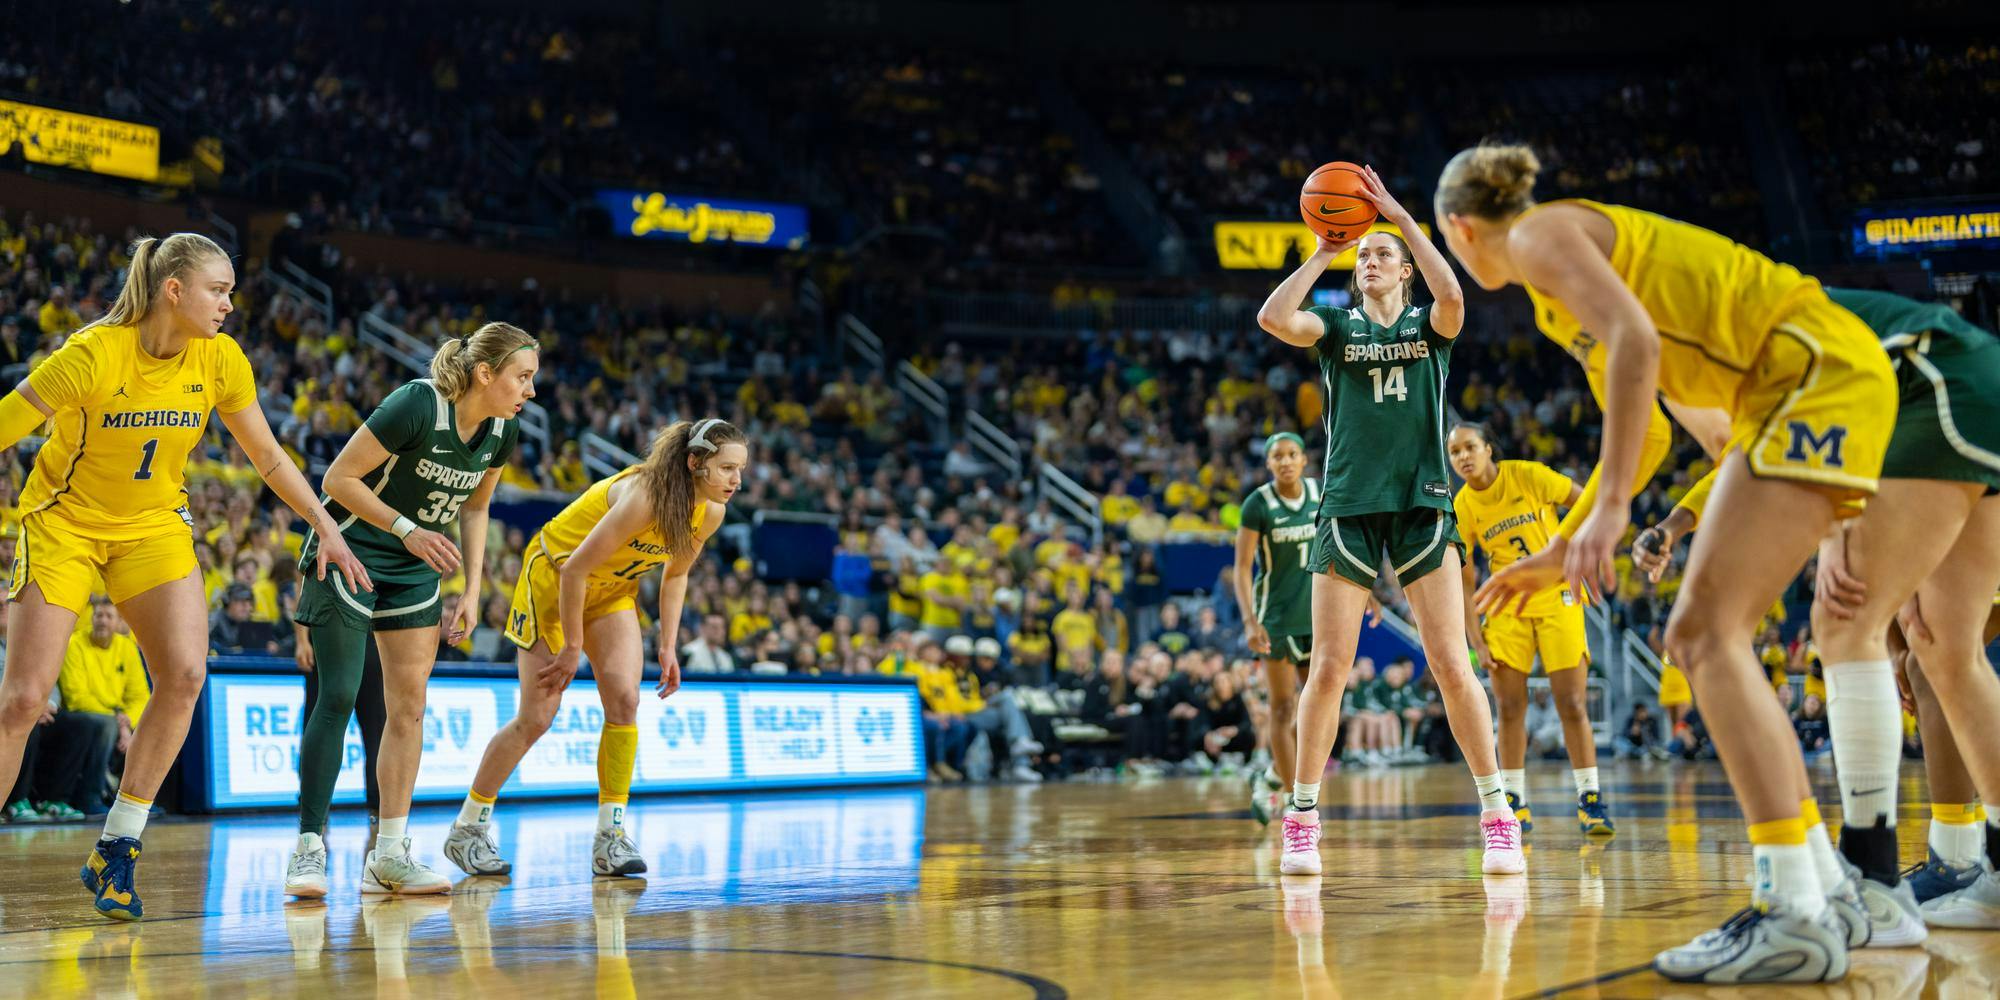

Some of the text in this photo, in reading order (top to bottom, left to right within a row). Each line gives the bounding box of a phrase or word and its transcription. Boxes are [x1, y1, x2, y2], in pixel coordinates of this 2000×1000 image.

[1326, 229, 1347, 239] M
[1344, 340, 1430, 362] SPARTANS
[1368, 366, 1408, 403] 14
[101, 409, 202, 429] MICHIGAN
[133, 438, 159, 480] 1
[1785, 421, 1847, 468] M
[415, 458, 486, 489] SPARTAN
[417, 491, 470, 524] 35
[1483, 511, 1536, 542] MICHIGAN
[1509, 536, 1530, 560] 3
[511, 609, 527, 637] M
[753, 705, 823, 732] READY
[247, 743, 285, 775] TO
